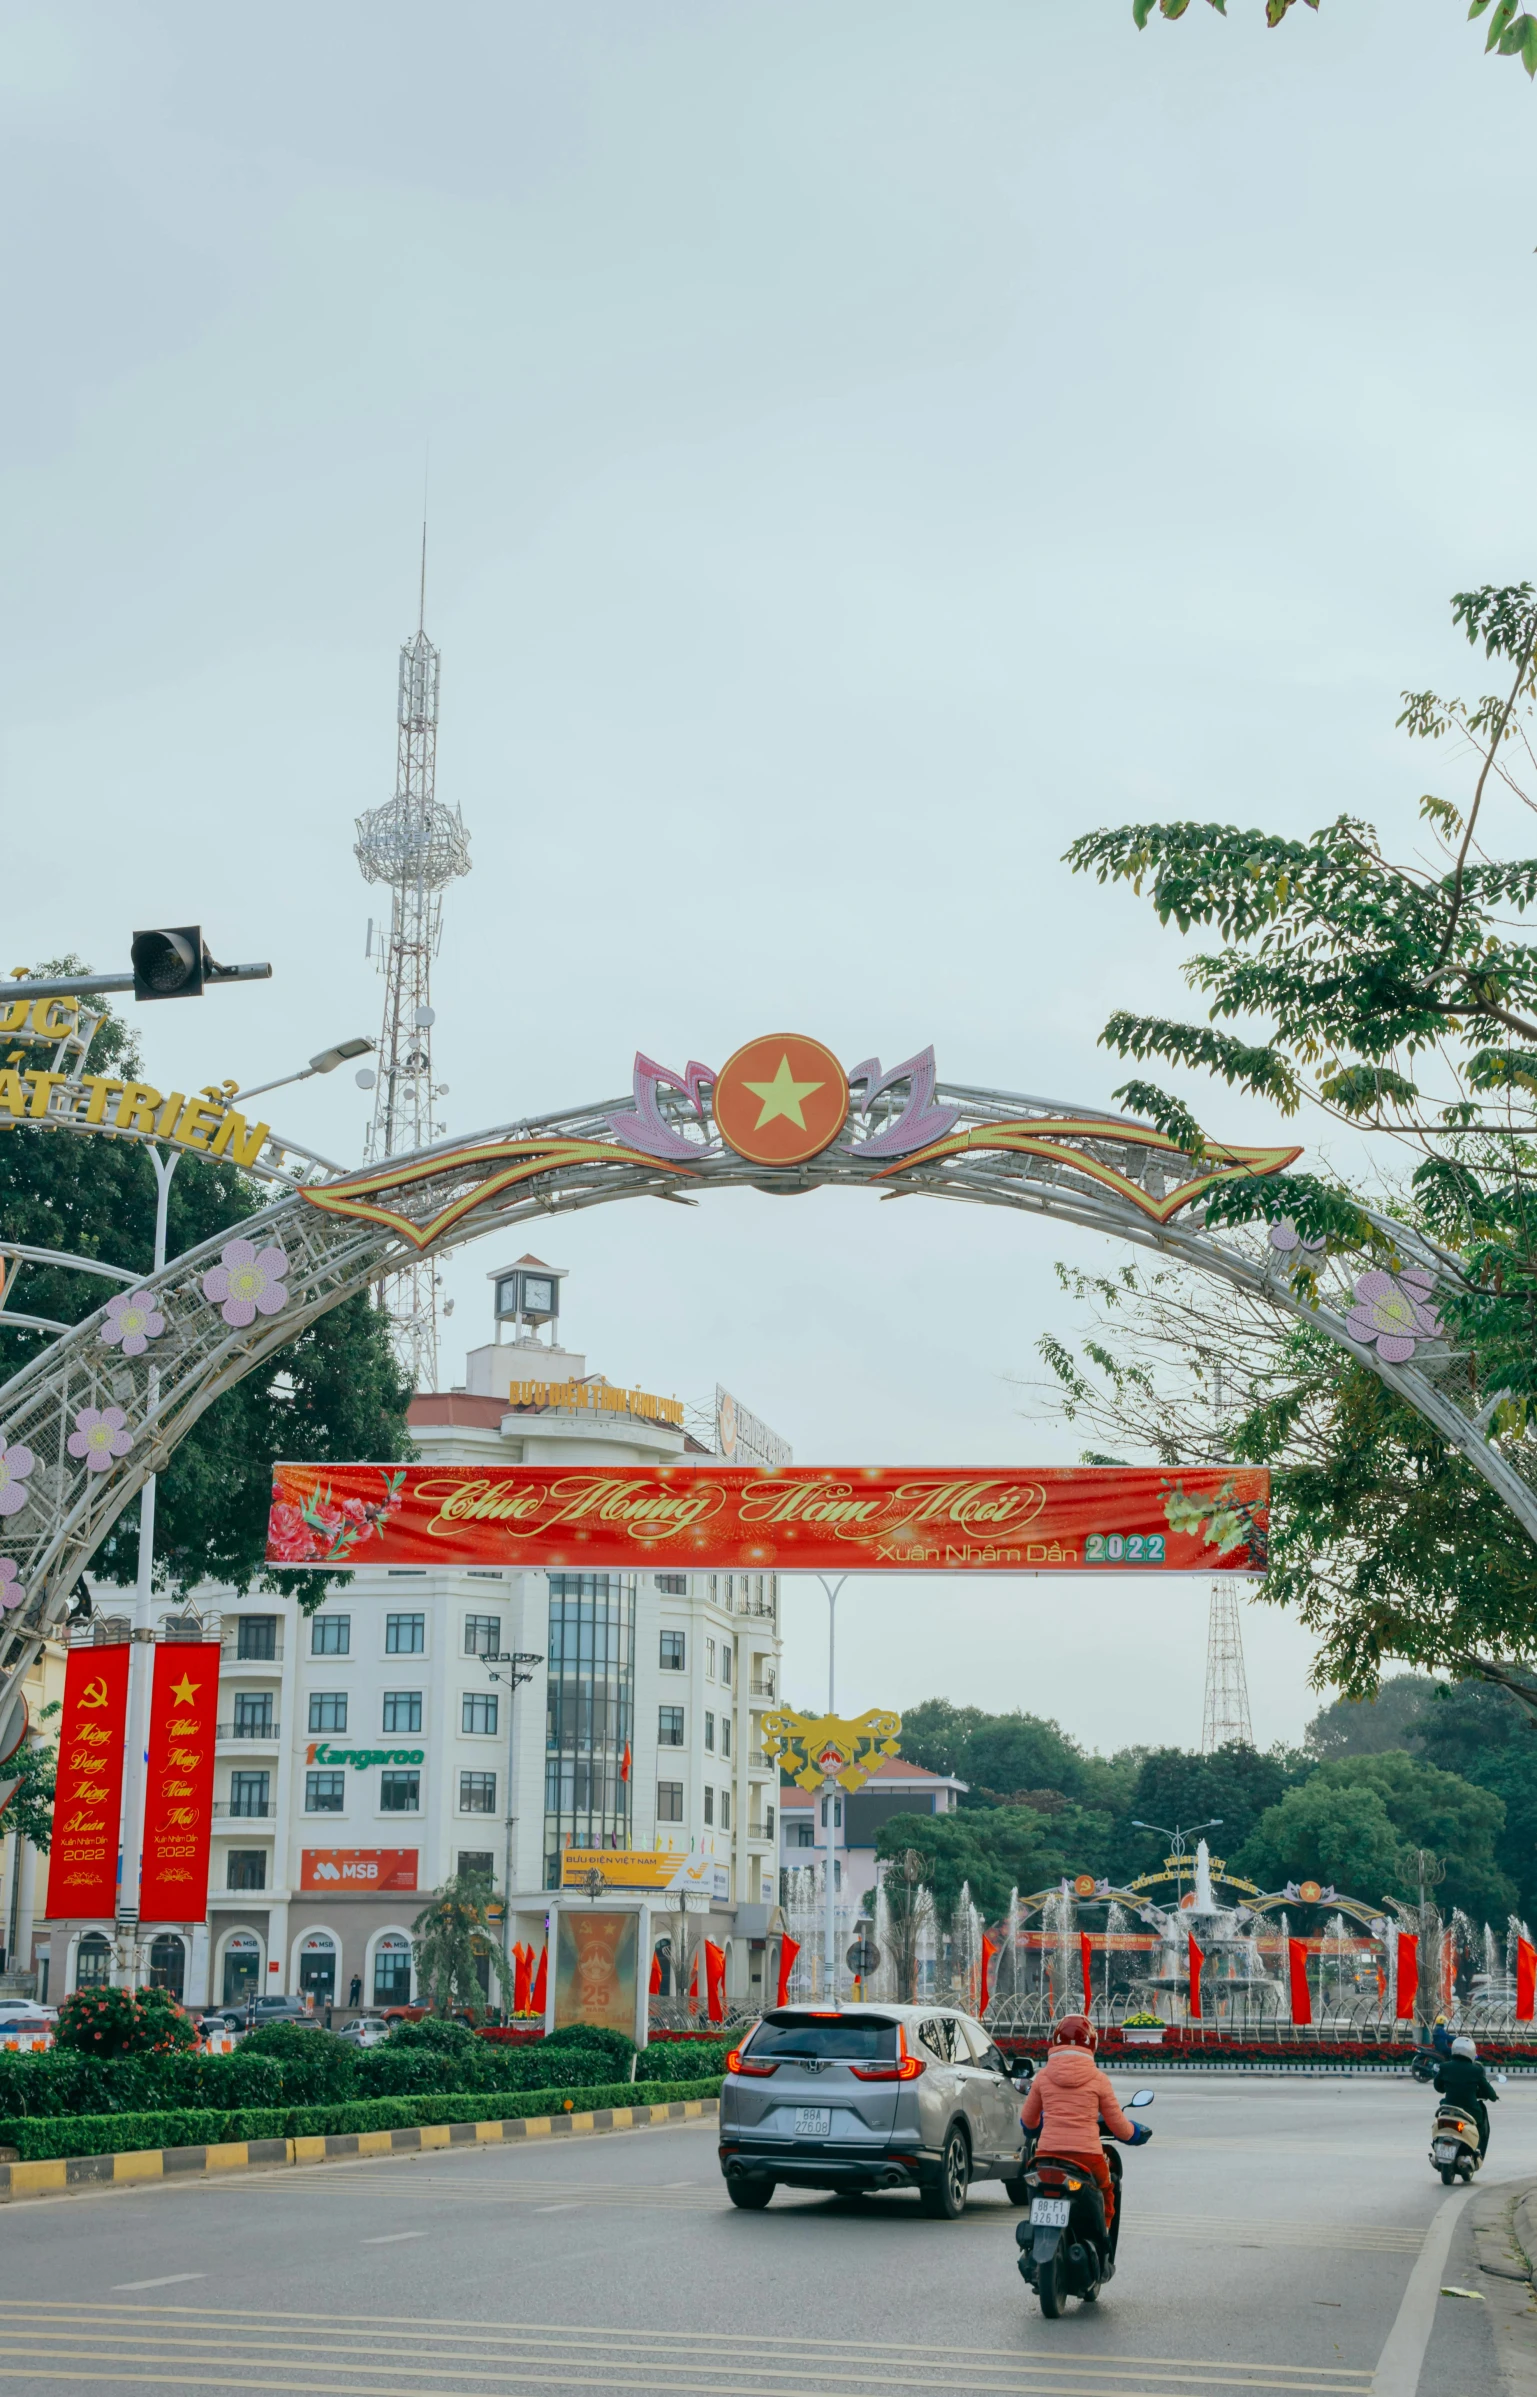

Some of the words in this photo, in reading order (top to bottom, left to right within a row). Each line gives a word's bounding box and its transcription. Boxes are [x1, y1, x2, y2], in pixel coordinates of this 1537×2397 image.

[81, 1074, 271, 1168] TRIỂN
[509, 1379, 545, 1406] BƯU
[549, 1376, 589, 1415] ĐIỆN
[591, 1375, 627, 1413] TỈNH
[629, 1384, 657, 1419] VĨNH
[658, 1393, 685, 1426] PHÚC
[413, 1478, 548, 1537] Chúc
[505, 1475, 727, 1541] Mừng
[738, 1479, 896, 1525] Năm
[834, 1479, 1047, 1540] Mới
[874, 1543, 940, 1562] Xuân
[945, 1543, 1021, 1562] Nhâm
[1026, 1540, 1077, 1562] Dần
[1085, 1533, 1166, 1562] 2022
[165, 1718, 202, 1743] Chúc
[305, 1743, 425, 1771] Kangaroo
[63, 1849, 106, 1861] 2022
[156, 1845, 196, 1858] 2022
[566, 1854, 588, 1863] BƯU
[589, 1854, 613, 1865] ĐIỆN
[614, 1855, 636, 1867] VIỆT
[342, 1863, 378, 1879] MSB
[583, 1984, 610, 2006] 25
[803, 2109, 821, 2121] 88A
[795, 2121, 828, 2133] 276.08
[1037, 2200, 1064, 2213] 88-F1
[1033, 2211, 1066, 2225] 326.19
